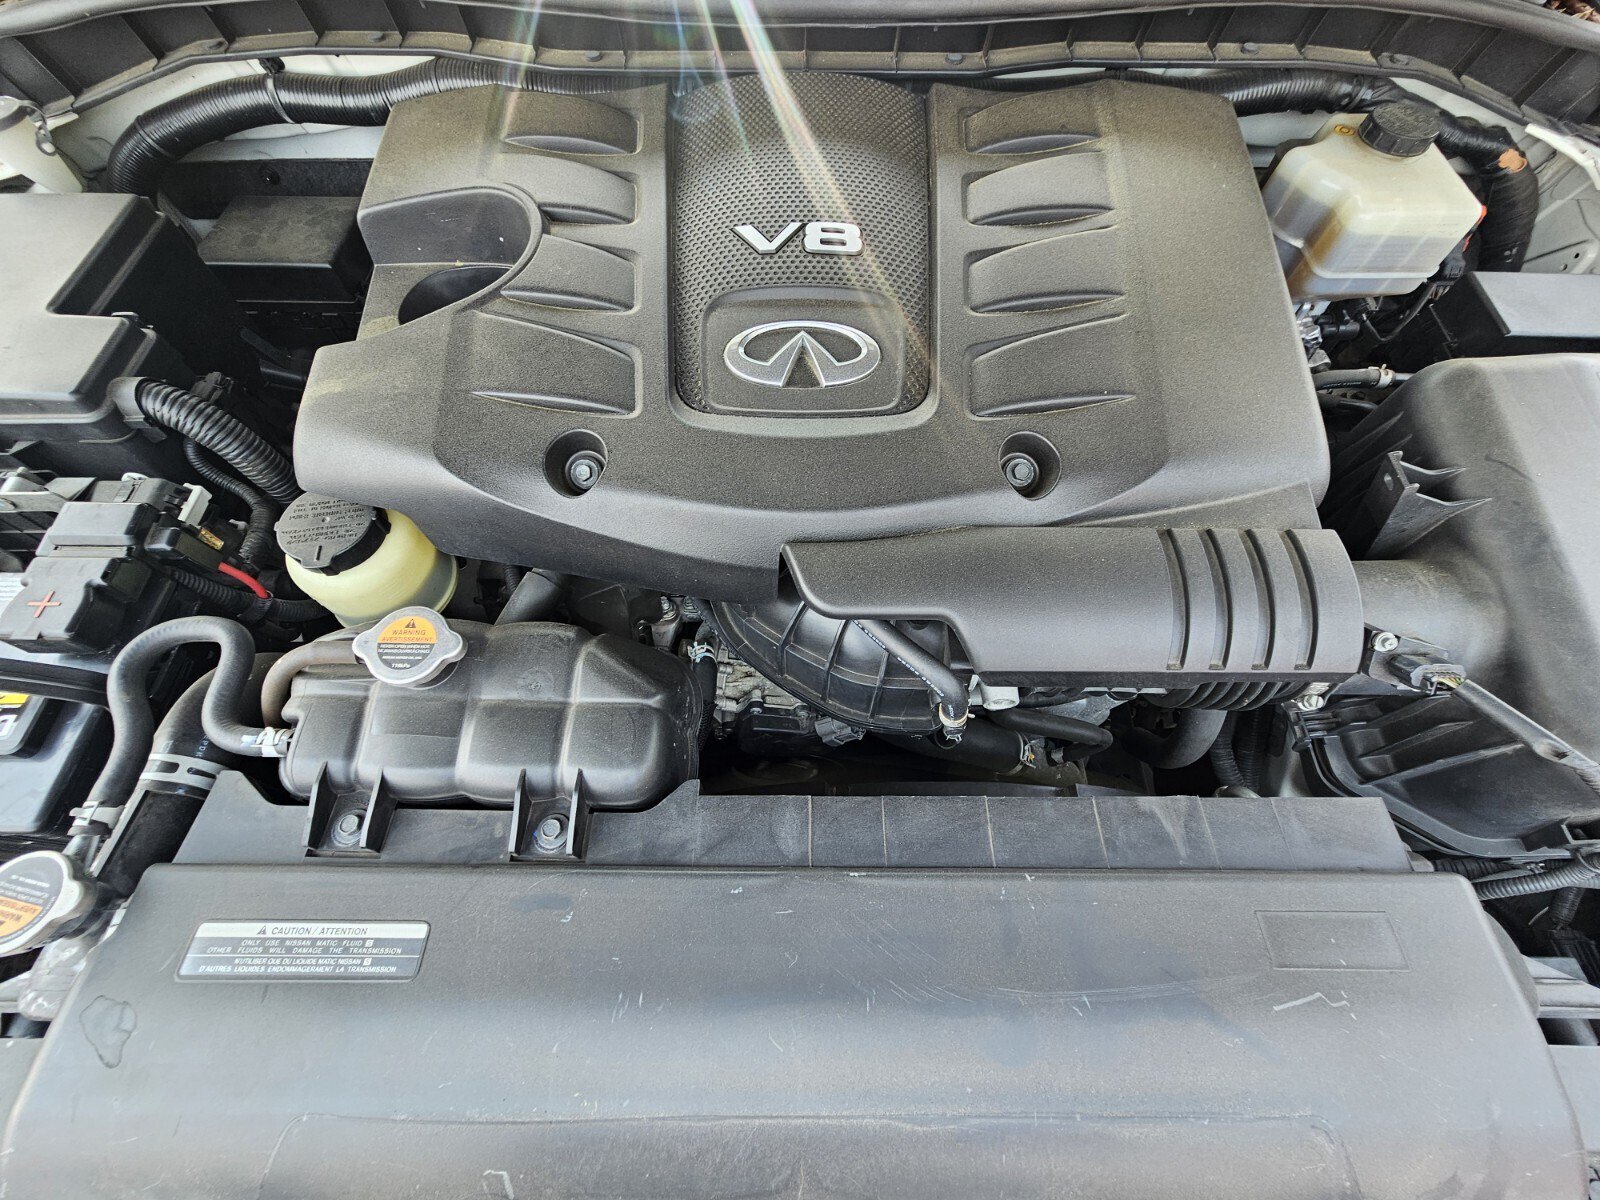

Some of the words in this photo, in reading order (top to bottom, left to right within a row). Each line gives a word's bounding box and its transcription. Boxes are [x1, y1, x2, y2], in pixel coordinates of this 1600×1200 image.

[731, 221, 865, 255] V8
[271, 927, 311, 935] CAUTION
[319, 927, 368, 935] ATTENTION
